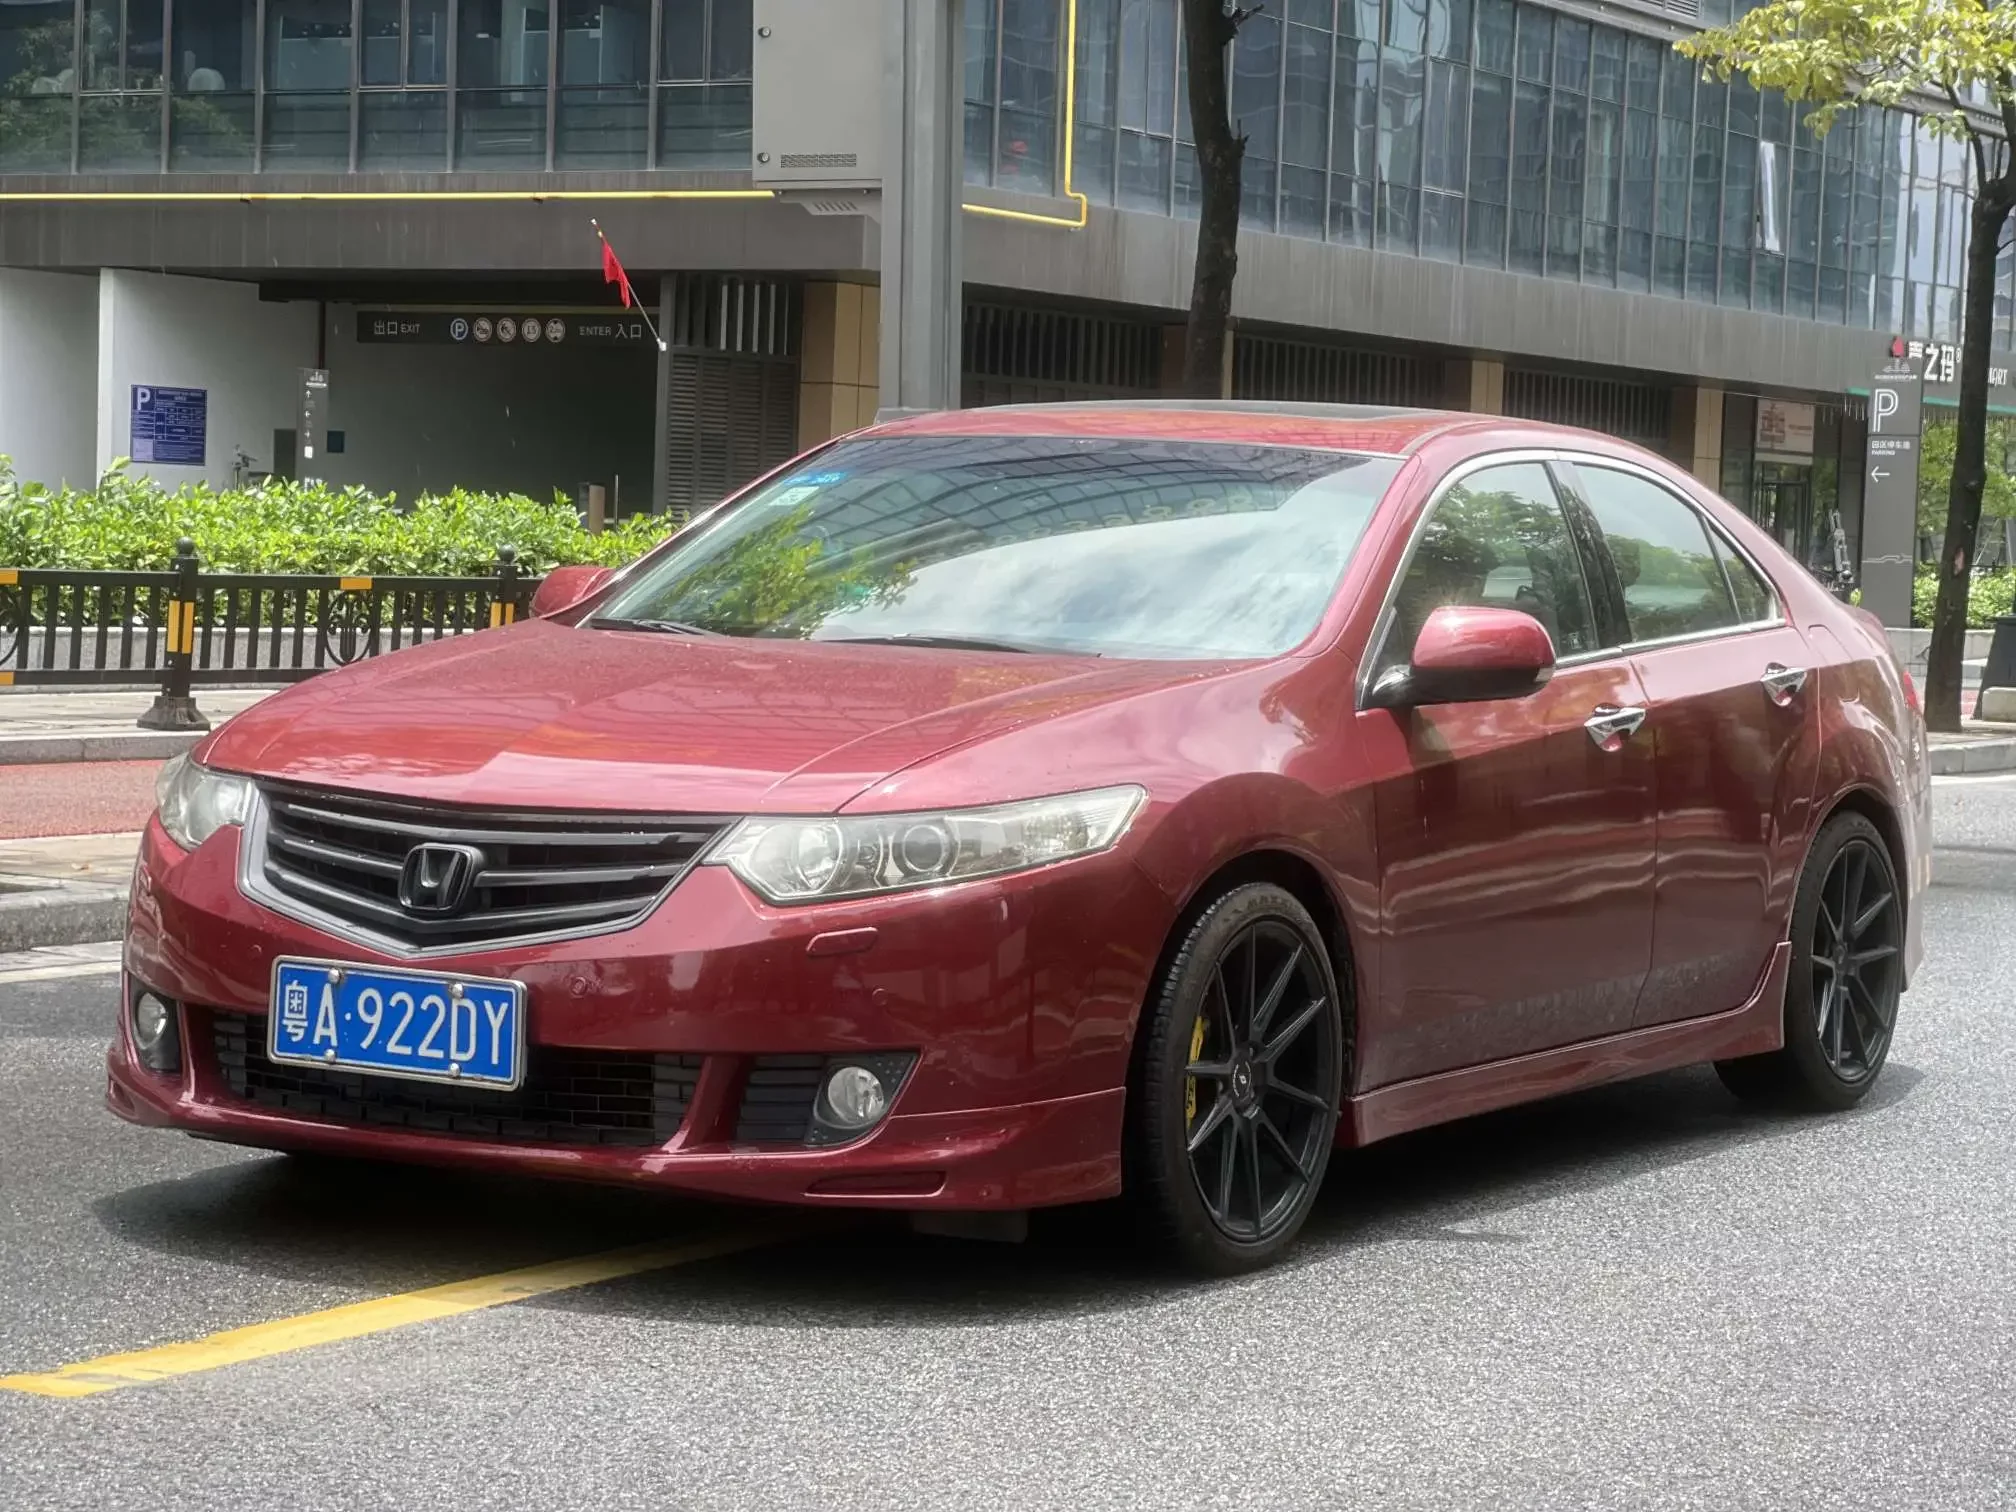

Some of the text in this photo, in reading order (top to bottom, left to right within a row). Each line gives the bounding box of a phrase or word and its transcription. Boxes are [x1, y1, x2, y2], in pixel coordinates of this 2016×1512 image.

[373, 319, 420, 335] 出口 EXIT
[580, 322, 642, 338] ENTER 入口
[137, 387, 151, 411] P
[1872, 388, 1899, 433] P
